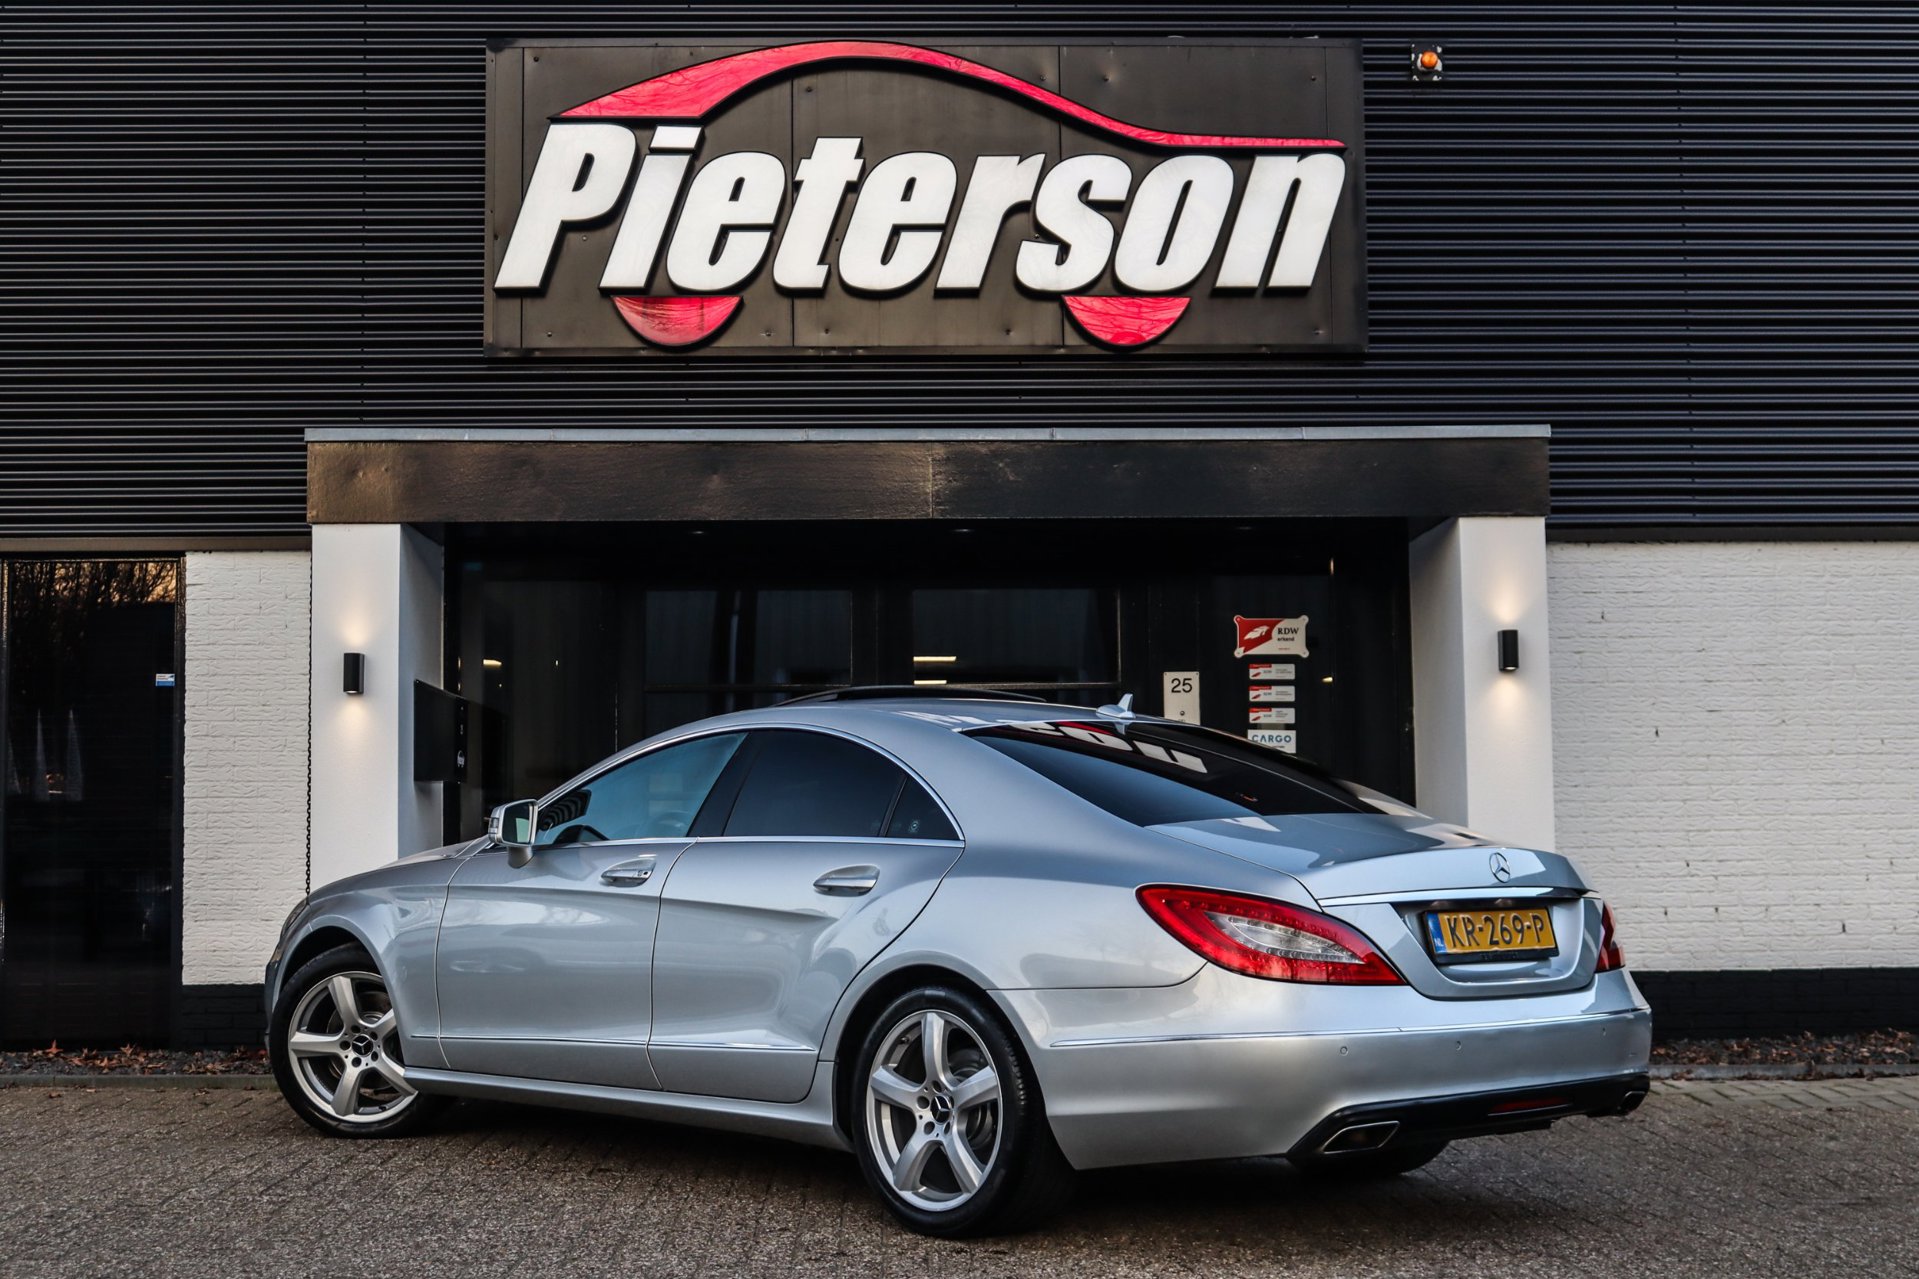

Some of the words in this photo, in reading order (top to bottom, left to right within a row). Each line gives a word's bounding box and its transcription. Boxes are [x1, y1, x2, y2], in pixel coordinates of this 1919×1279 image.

[495, 122, 1346, 294] Pieterson
[1277, 627, 1299, 635] RDW
[1171, 678, 1193, 693] 25
[1252, 734, 1292, 743] CARGO
[1445, 913, 1544, 948] KR-269-P
